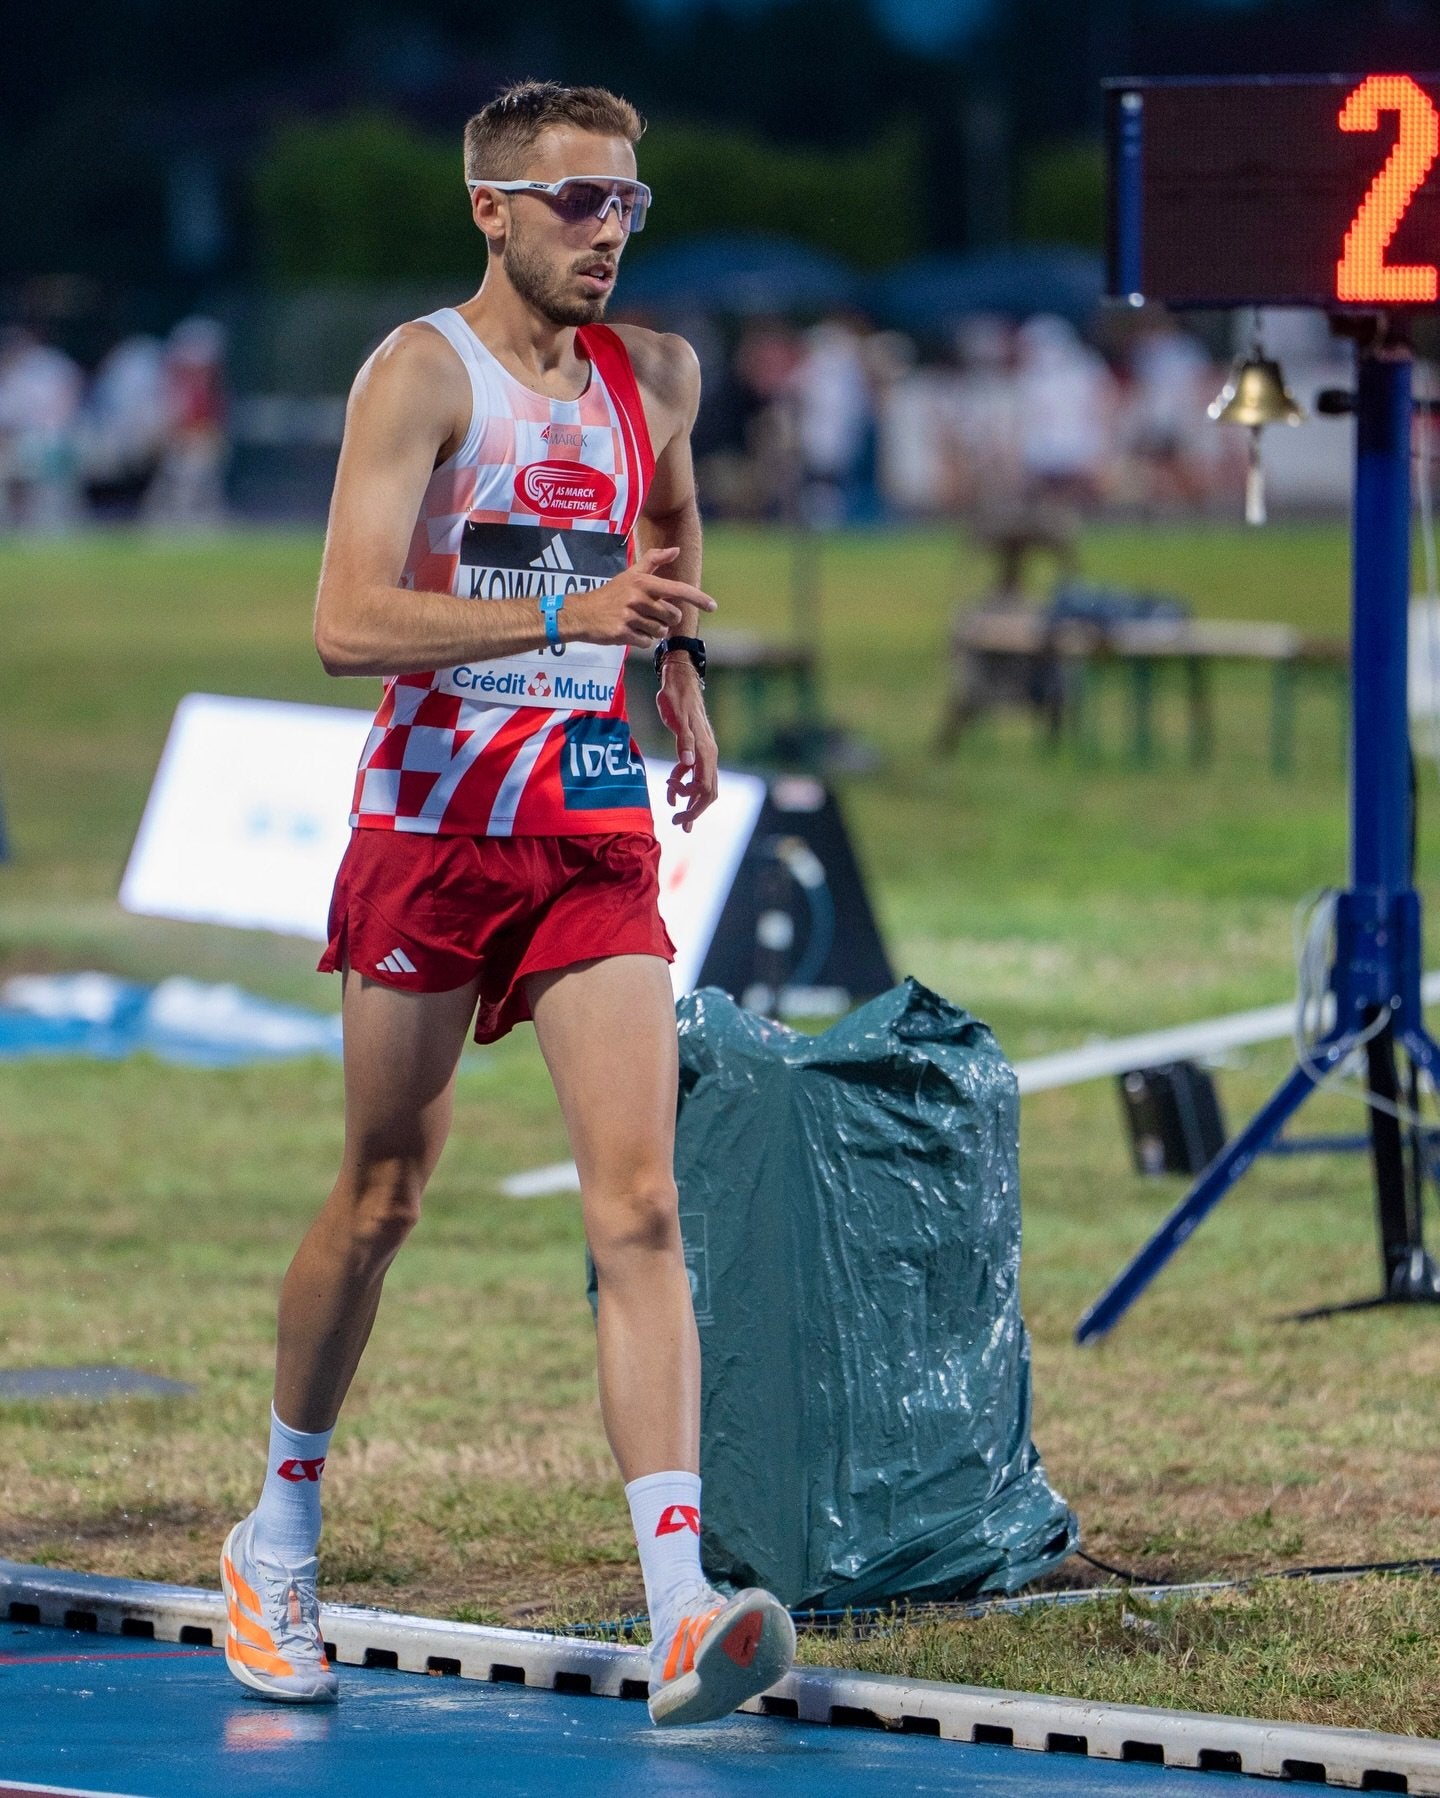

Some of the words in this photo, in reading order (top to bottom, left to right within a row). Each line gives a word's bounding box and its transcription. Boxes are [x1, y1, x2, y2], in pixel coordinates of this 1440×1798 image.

[1337, 75, 1438, 301] 2
[549, 433, 588, 447] MARCK
[555, 486, 565, 496] AS
[565, 487, 595, 498] MARCK
[550, 499, 597, 511] ATHLETISME
[452, 666, 526, 695] Crédit
[554, 676, 615, 702] Mutue
